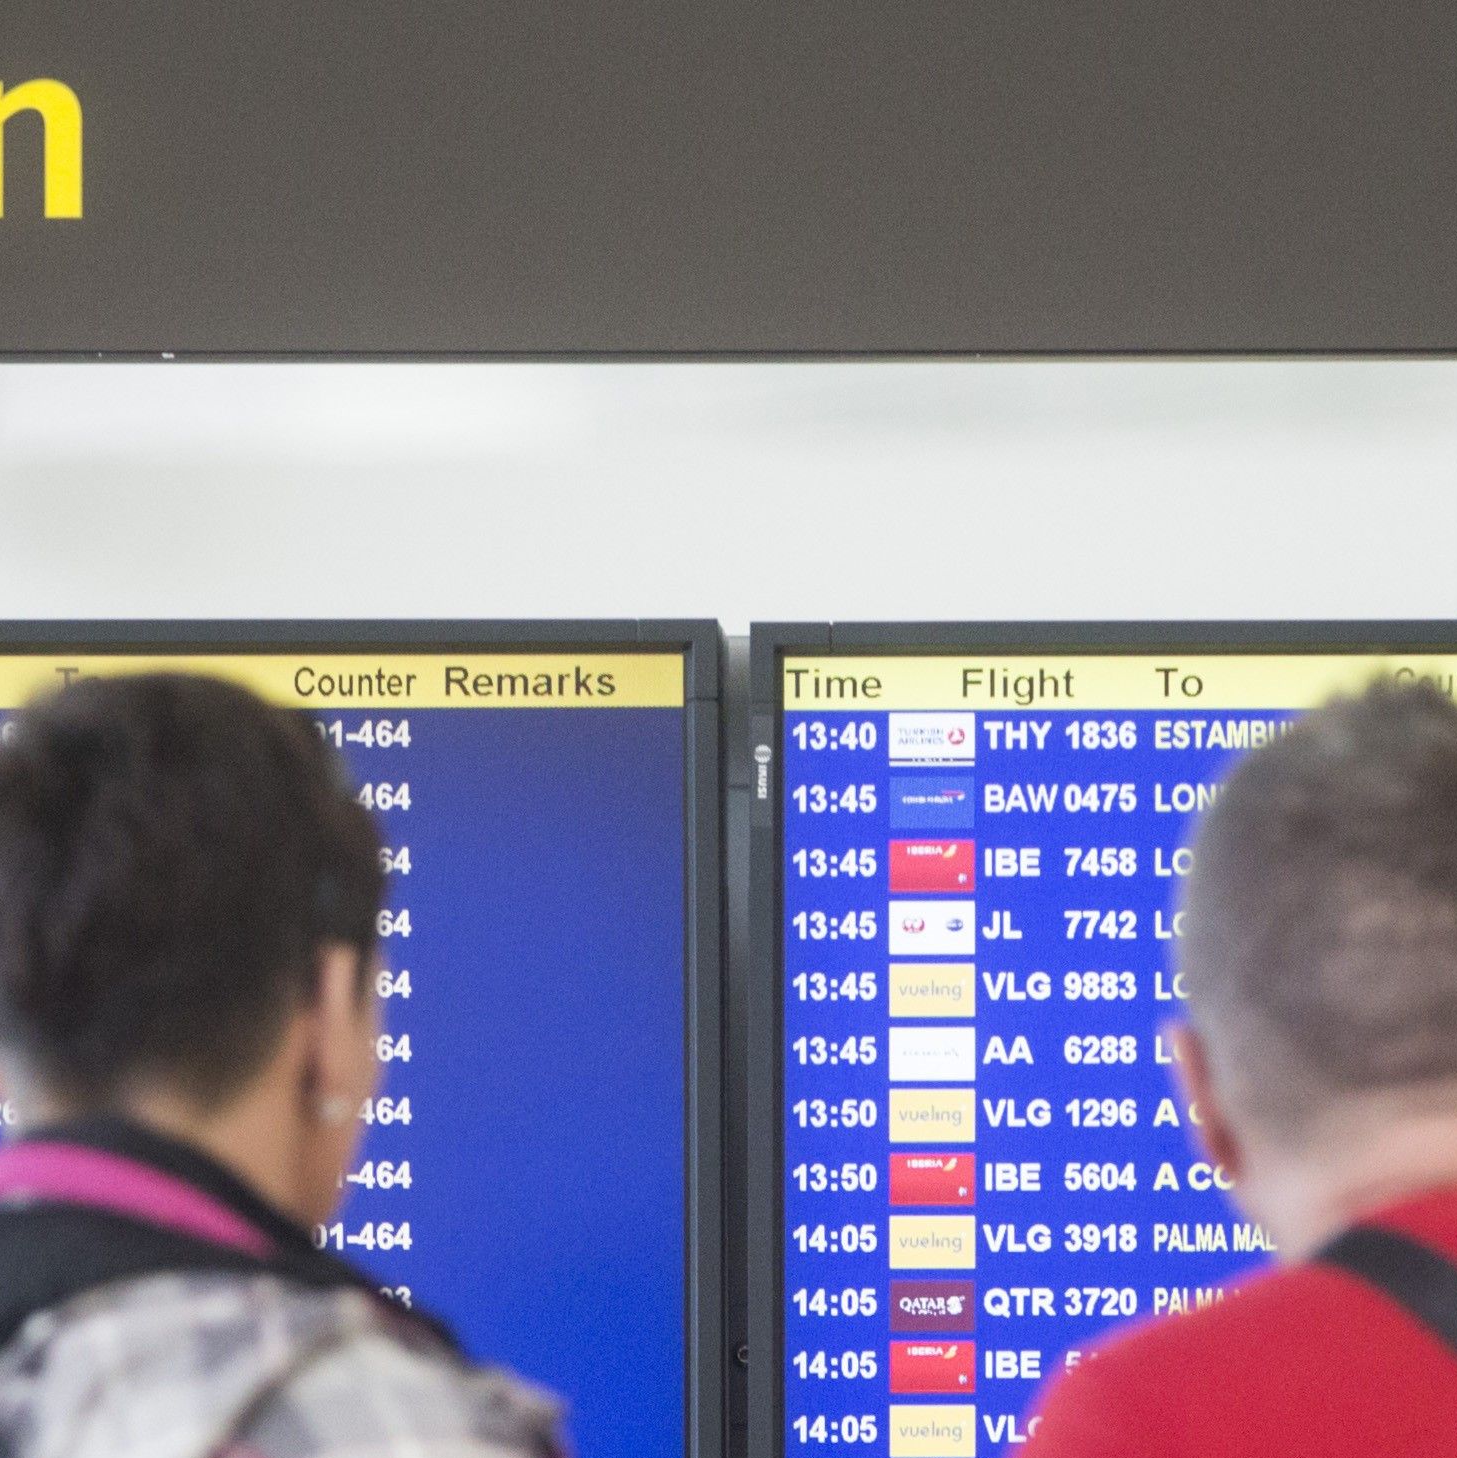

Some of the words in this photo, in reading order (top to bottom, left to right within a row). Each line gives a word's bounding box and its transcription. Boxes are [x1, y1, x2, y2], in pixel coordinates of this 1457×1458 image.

[294, 666, 417, 697] Counter
[444, 665, 616, 697] Remarks
[785, 668, 882, 699] Time
[962, 668, 1074, 703] Flight
[1155, 667, 1204, 697] To
[792, 721, 877, 750] 13:40
[983, 720, 1052, 750] THY
[1065, 720, 1137, 750] 1836
[792, 784, 877, 813] 13:45
[984, 783, 1059, 813] BAW
[1063, 783, 1137, 813] 0475
[792, 971, 878, 1001] 13:45
[981, 971, 1052, 1001] VLG
[1063, 971, 1138, 1001] 9883
[793, 1098, 878, 1128] 13:50
[982, 1098, 1052, 1128] VLG
[1065, 1098, 1138, 1127] 1296
[1153, 1098, 1179, 1127] A
[792, 1224, 878, 1253] 14:05
[982, 1223, 1052, 1253] VLG
[1064, 1223, 1138, 1253] 3918
[1153, 1225, 1228, 1253] PALMA
